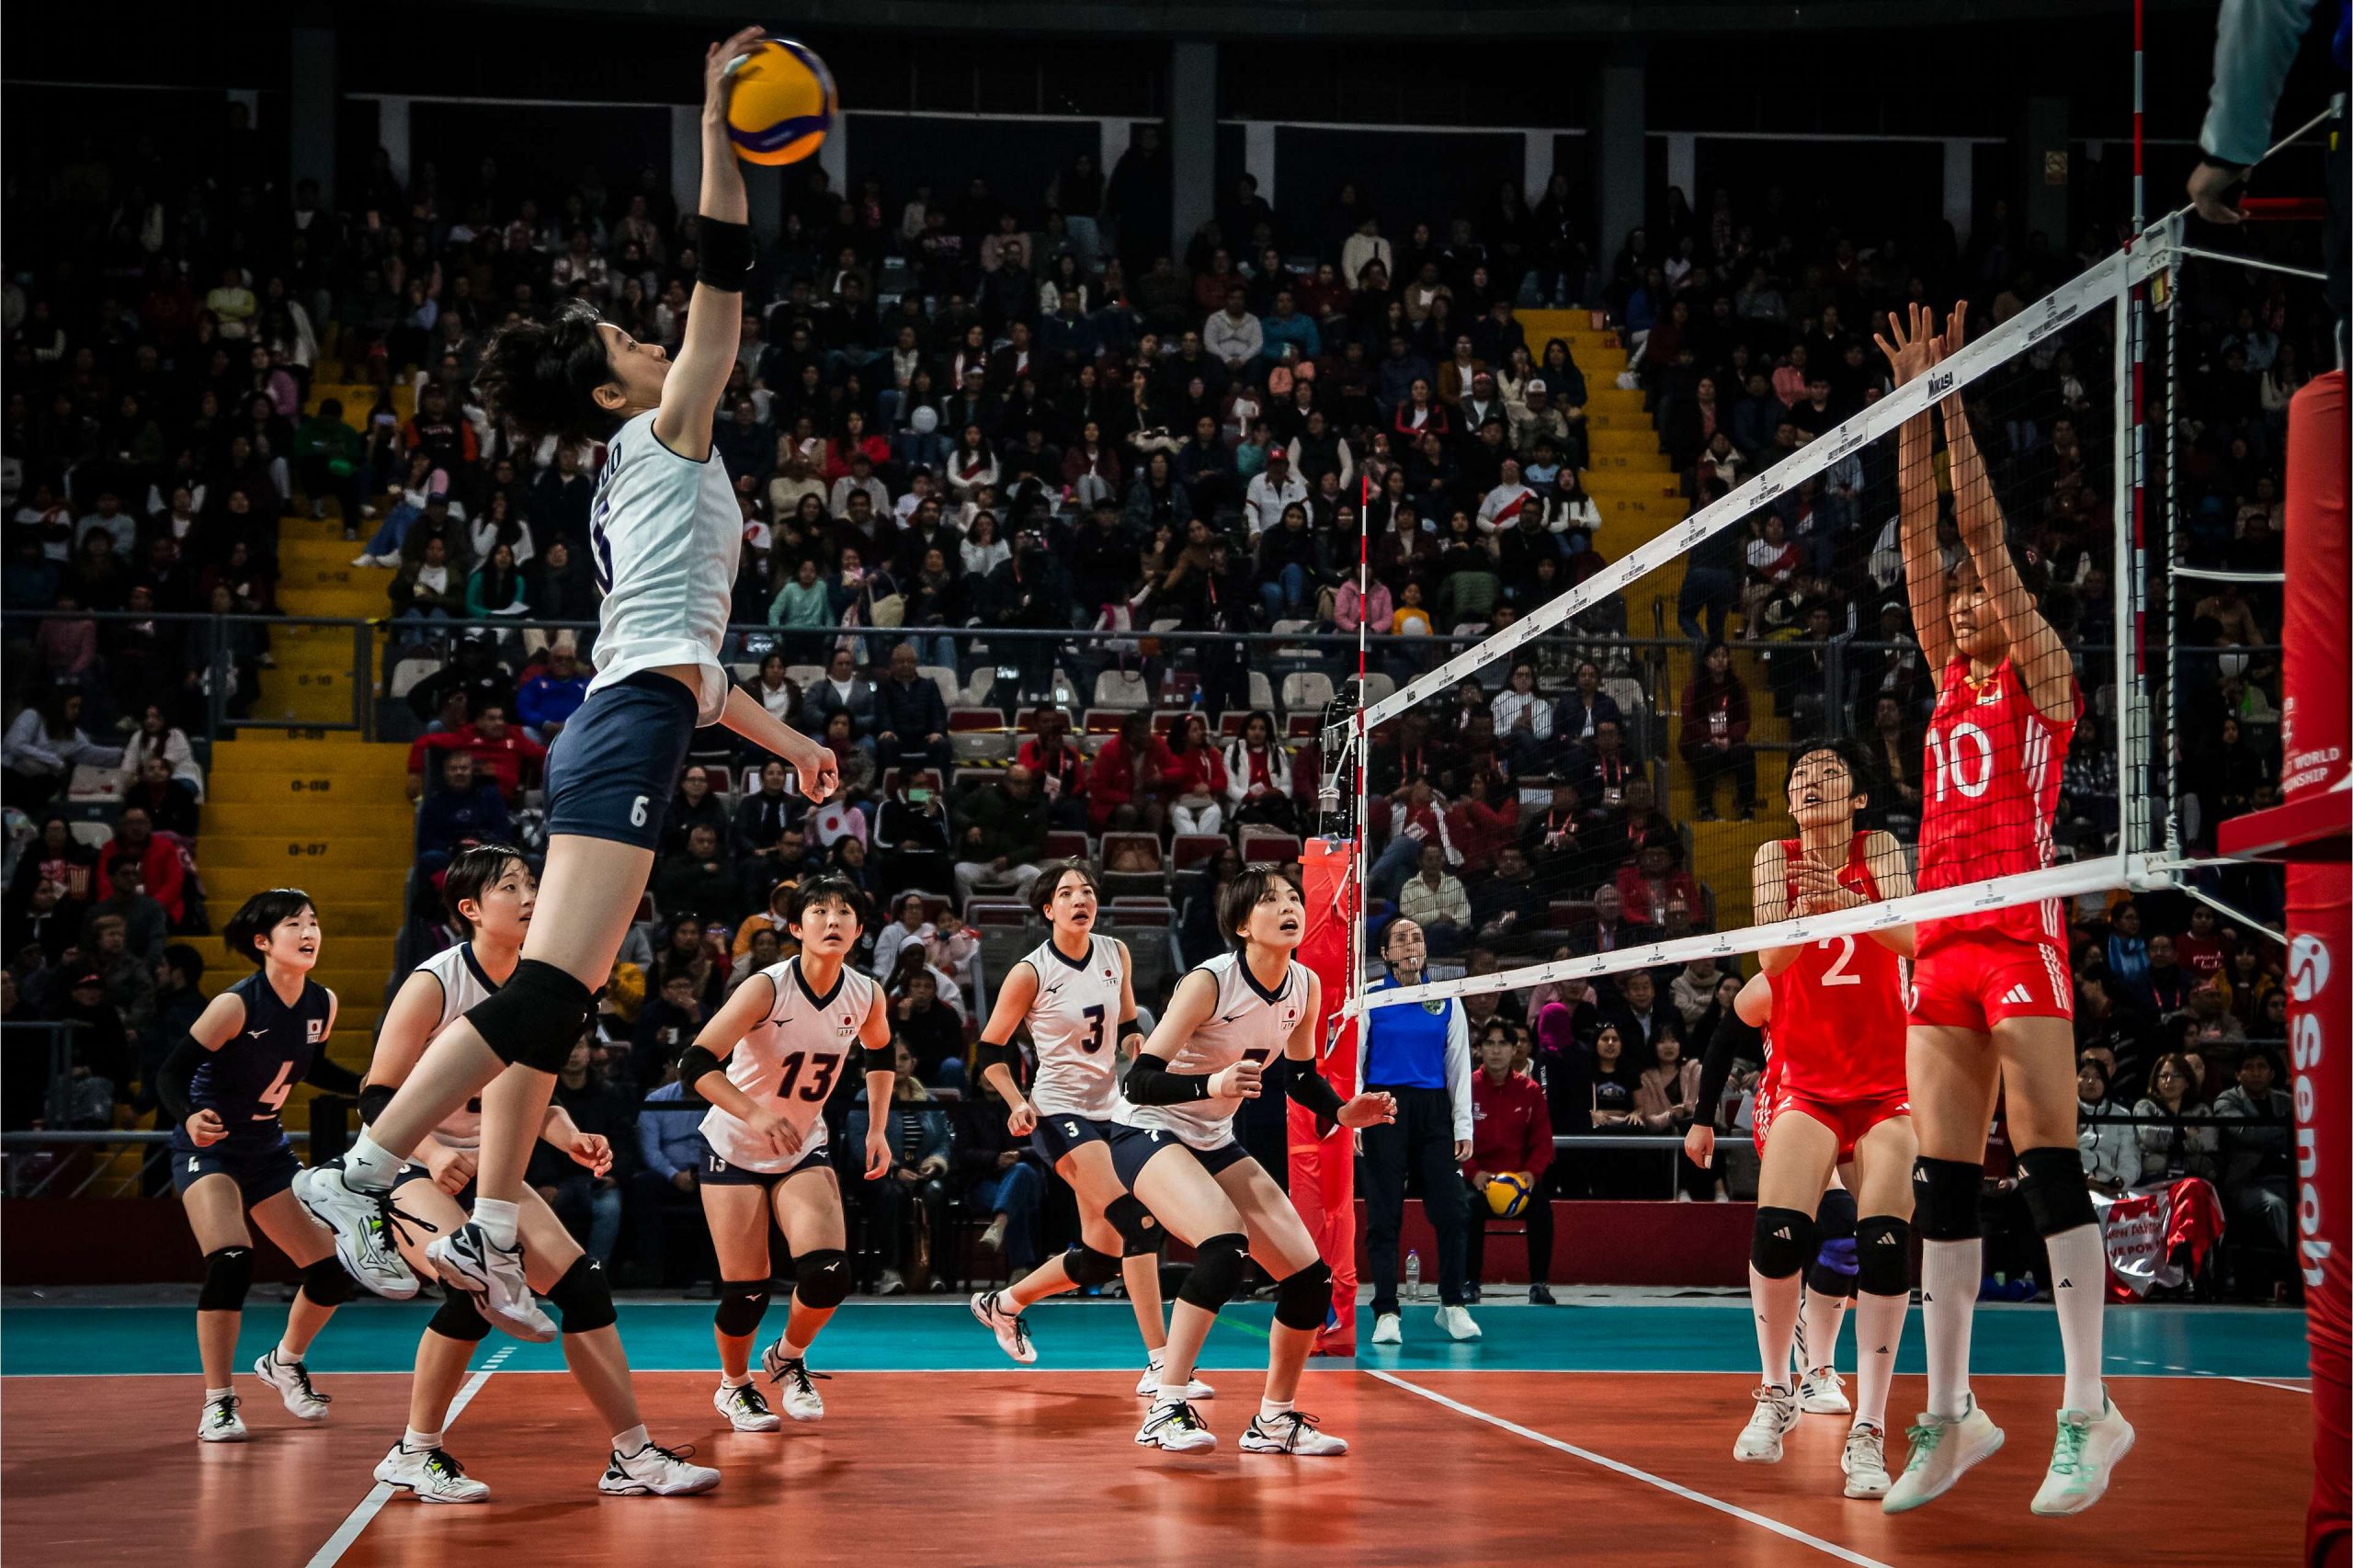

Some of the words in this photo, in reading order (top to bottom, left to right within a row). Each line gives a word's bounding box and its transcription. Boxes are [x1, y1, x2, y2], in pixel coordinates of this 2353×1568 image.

[1927, 371, 1954, 400] MIKASA
[1926, 722, 1992, 802] 10
[2294, 746, 2341, 770] WORLD
[630, 795, 650, 827] 6
[1818, 934, 1861, 986] 2
[1081, 1004, 1106, 1054] 3
[258, 1061, 295, 1112] 4
[776, 1051, 841, 1102] 13
[1063, 1119, 1080, 1138] 3
[2292, 1013, 2332, 1287] Senoh
